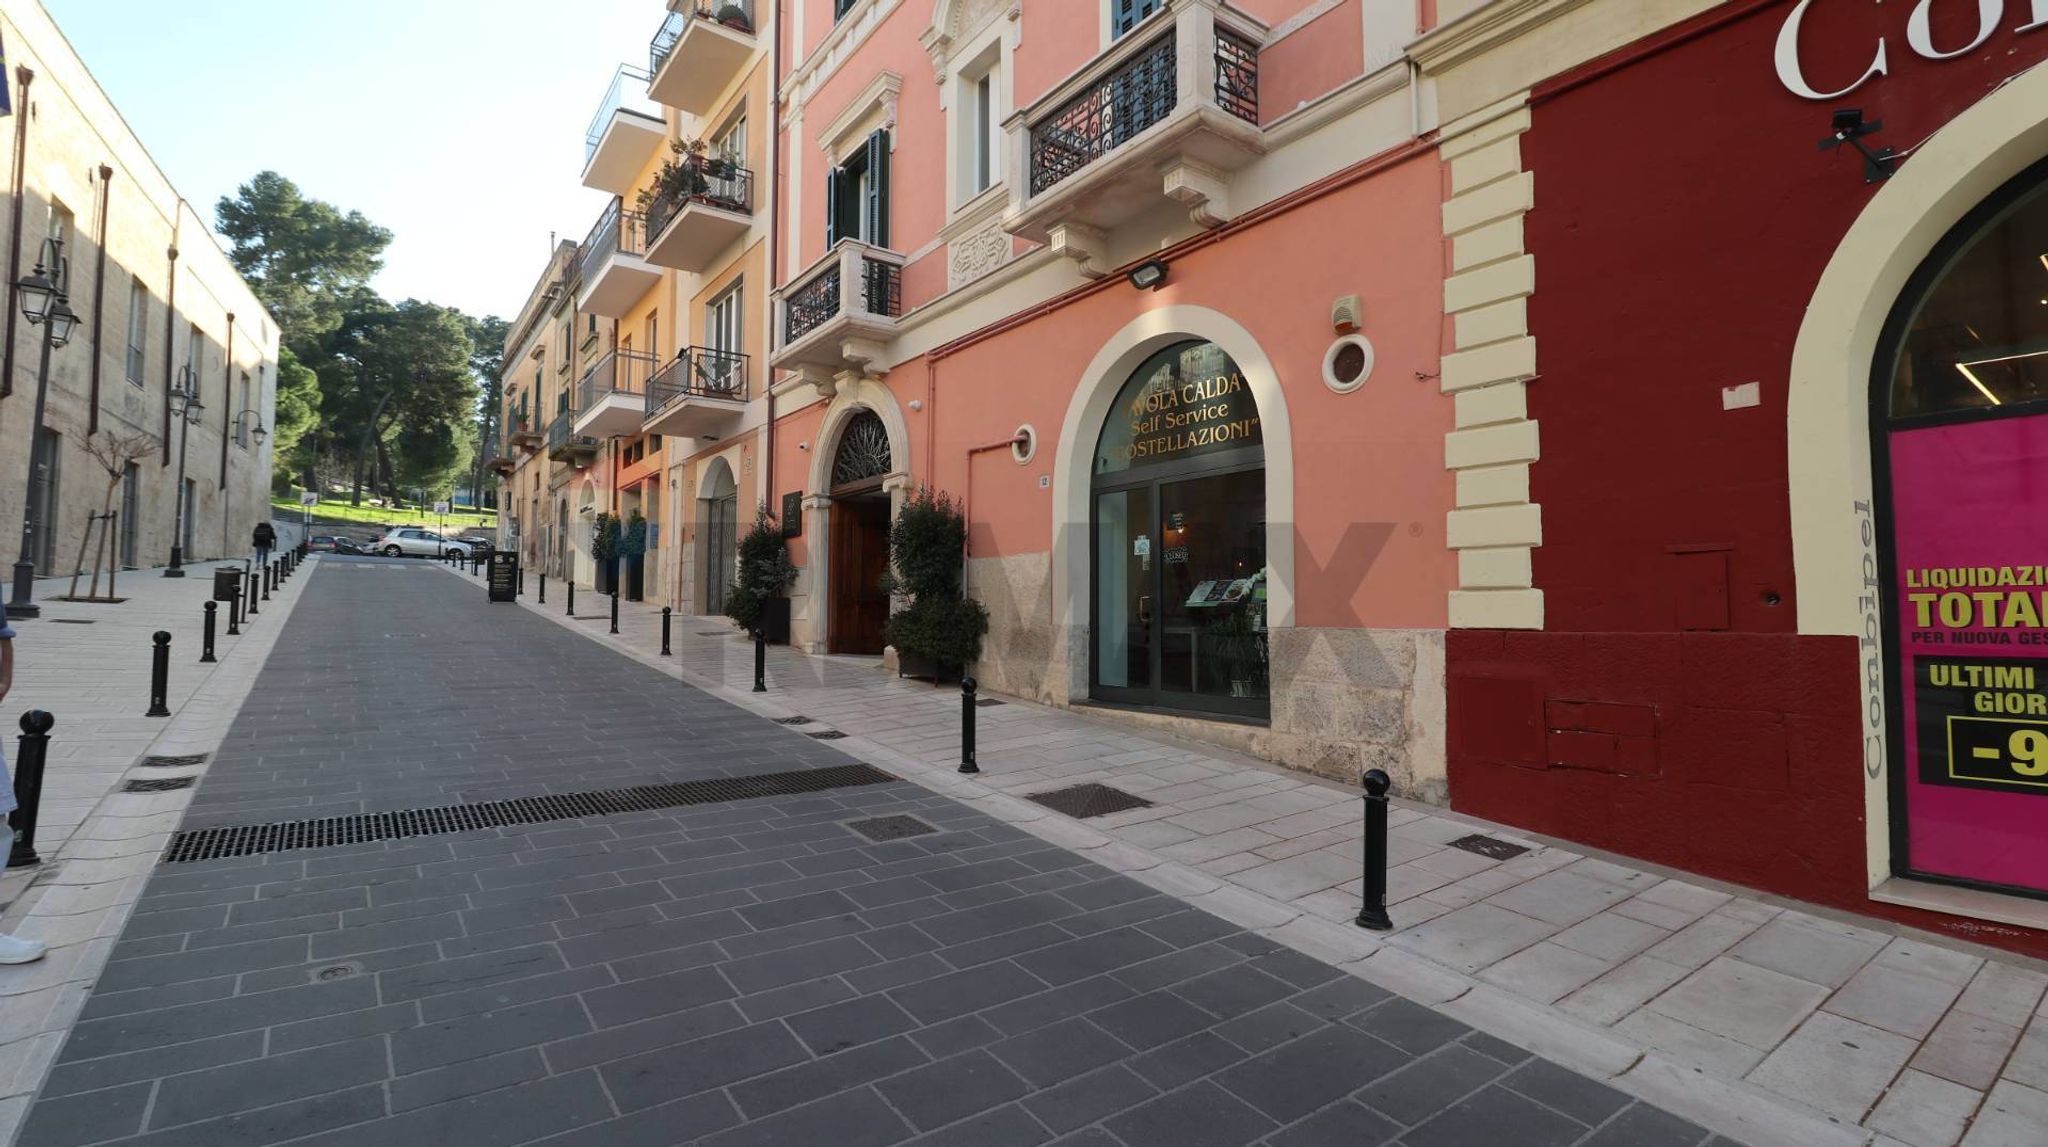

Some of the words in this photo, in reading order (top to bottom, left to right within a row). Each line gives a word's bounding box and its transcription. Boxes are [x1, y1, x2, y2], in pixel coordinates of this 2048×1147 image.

[1774, 0, 2048, 99] Co
[1183, 372, 1241, 404] CALDA
[1131, 413, 1160, 436] Self
[1166, 403, 1228, 430] Service
[1907, 566, 2048, 588] LIQUIDAZI
[1854, 499, 1881, 780] Conbipel
[1911, 631, 1944, 644] PER
[1951, 632, 2011, 645] NUOVA
[1929, 665, 2034, 690] ULTIMI
[1974, 691, 2048, 715] GIOR
